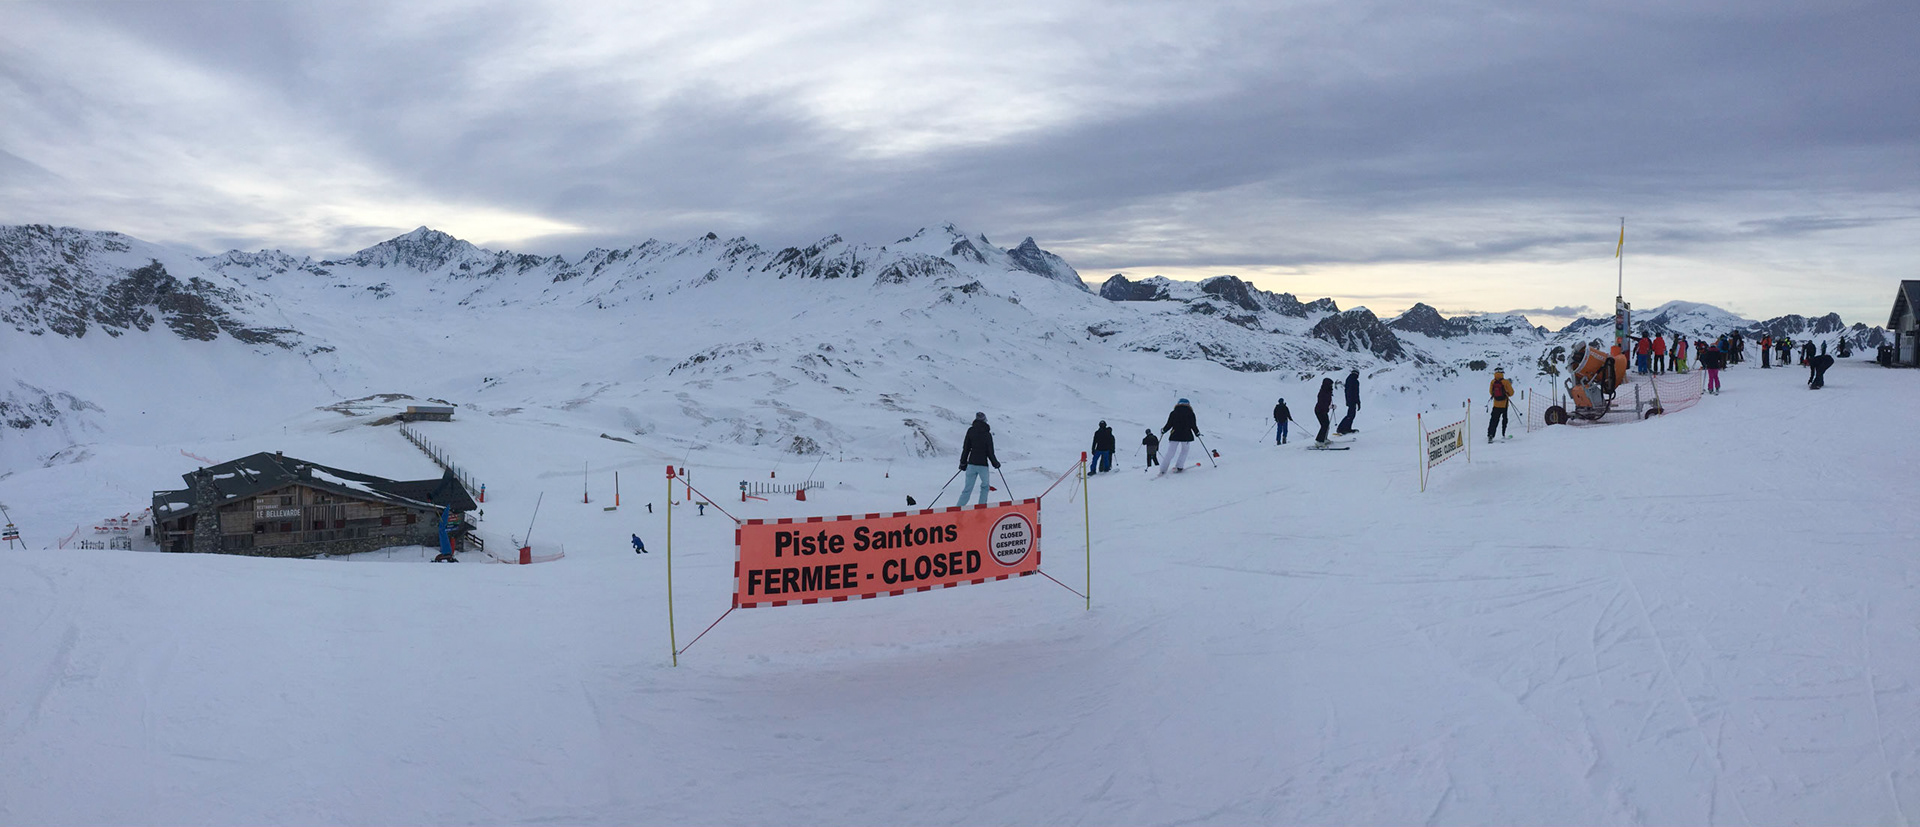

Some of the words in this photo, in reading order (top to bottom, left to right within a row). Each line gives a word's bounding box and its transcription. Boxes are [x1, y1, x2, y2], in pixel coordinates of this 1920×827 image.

[1443, 441, 1456, 454] CLOSED
[256, 510, 264, 519] LE
[266, 509, 301, 517] BELLEVARDE
[1001, 522, 1022, 530] FERME
[1000, 531, 1023, 539] CLOSED
[775, 529, 844, 557] Piste
[853, 523, 957, 551] Santons
[996, 539, 1027, 548] GESPERRT
[997, 548, 1026, 557] CERRADO
[748, 563, 858, 595] FERMEE
[882, 549, 982, 583] CLOSED
